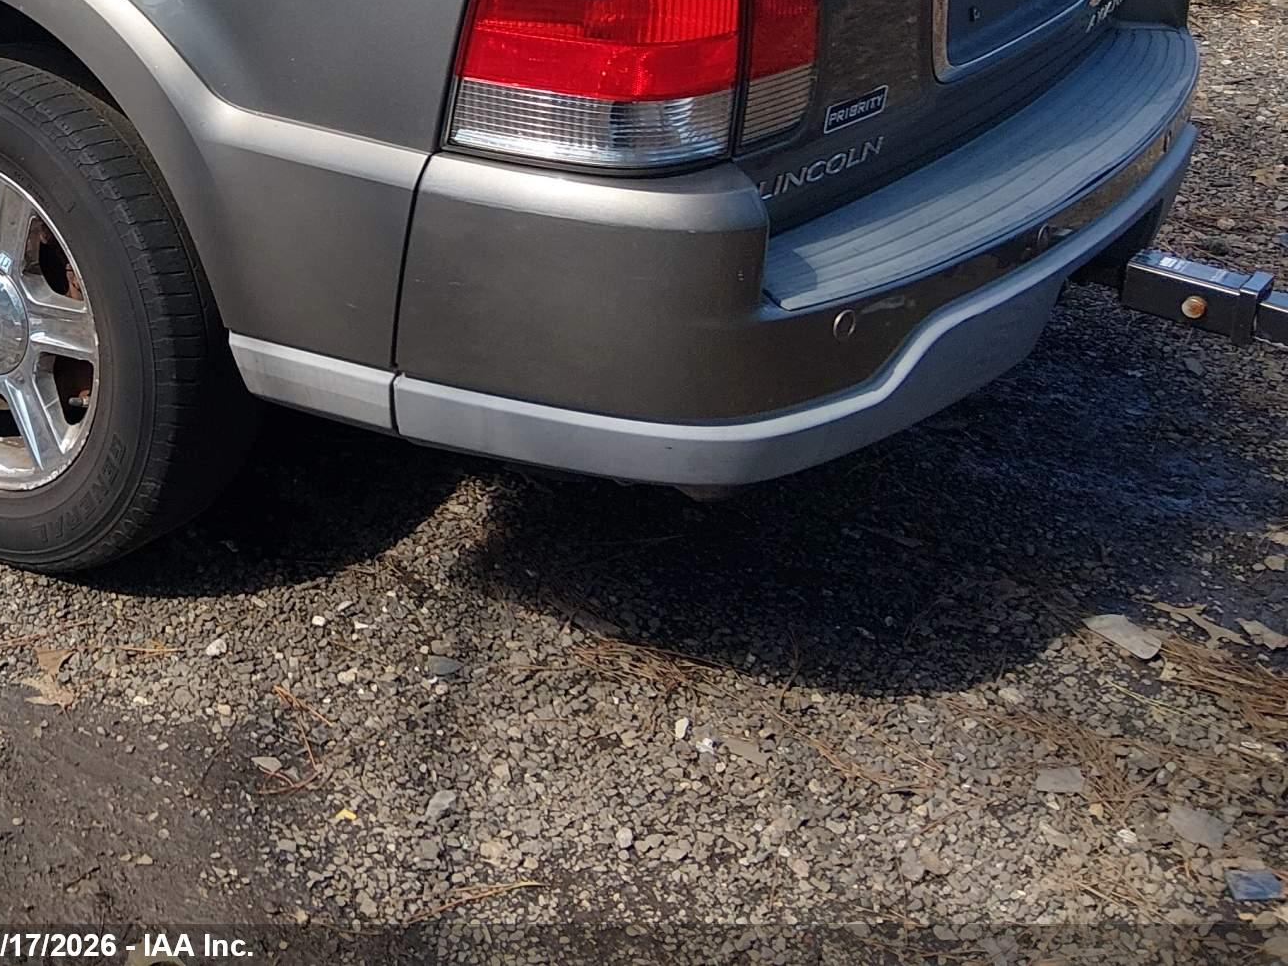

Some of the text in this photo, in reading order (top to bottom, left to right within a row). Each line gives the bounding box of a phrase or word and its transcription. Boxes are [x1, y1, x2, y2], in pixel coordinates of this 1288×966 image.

[827, 93, 885, 126] PRIORITY
[758, 136, 886, 200] LINCOLN
[31, 432, 128, 544] GENERAL
